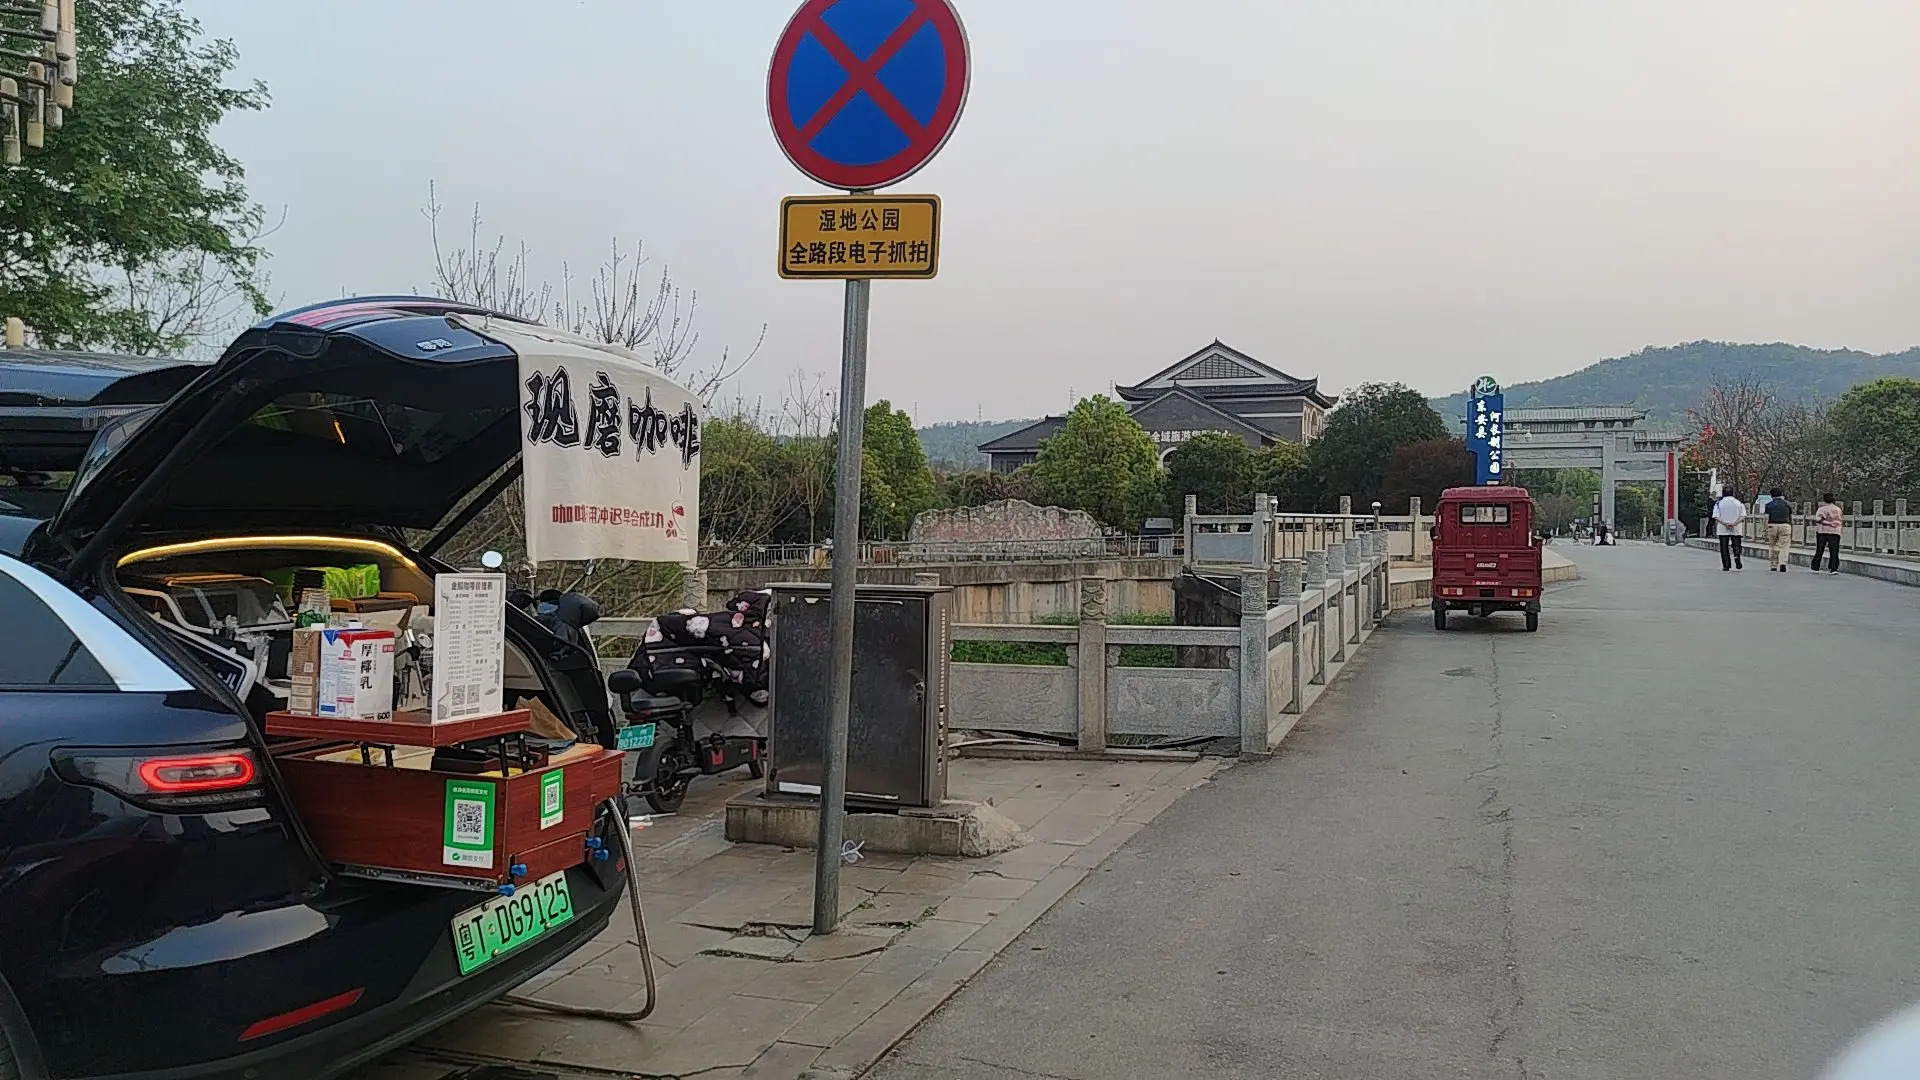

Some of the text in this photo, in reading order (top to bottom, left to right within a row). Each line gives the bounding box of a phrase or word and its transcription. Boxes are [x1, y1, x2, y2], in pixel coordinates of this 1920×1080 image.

[818, 208, 900, 232] 湿地公园
[789, 240, 929, 265] 全路段电子抓拍
[524, 366, 701, 470] 现磨咖啡
[1474, 399, 1488, 439] 东安县
[360, 643, 373, 690] 厚椰乳
